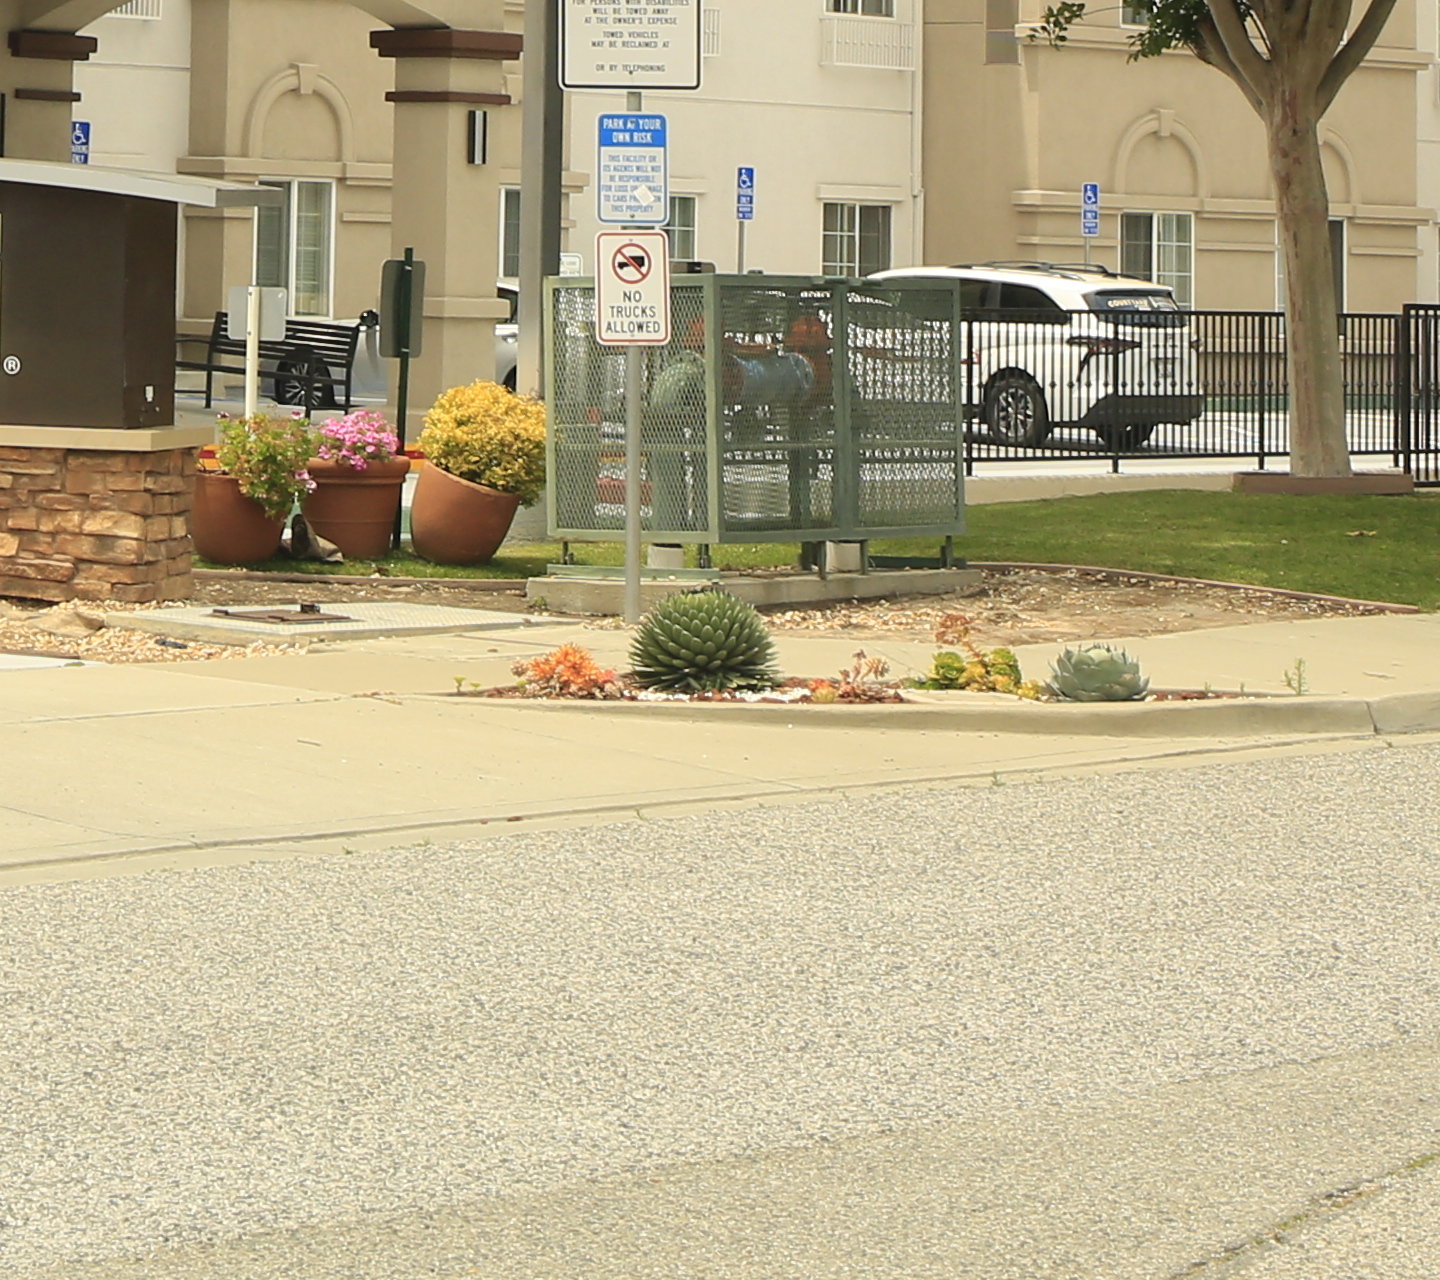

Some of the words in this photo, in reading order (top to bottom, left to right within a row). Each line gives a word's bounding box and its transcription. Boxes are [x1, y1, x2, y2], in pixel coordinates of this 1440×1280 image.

[596, 64, 605, 72] OR
[610, 64, 617, 72] BY
[622, 64, 666, 72] TELEPHONING
[603, 118, 625, 130] PARK
[627, 118, 636, 130] AT
[638, 118, 662, 130] YOUR
[612, 132, 630, 143] OWN
[633, 132, 653, 143] RISK
[612, 205, 624, 213] THIS
[626, 205, 654, 213] PROPERTY
[623, 291, 642, 303] NO
[610, 306, 656, 318] TRUCKS
[605, 321, 660, 333] ALLOWED
